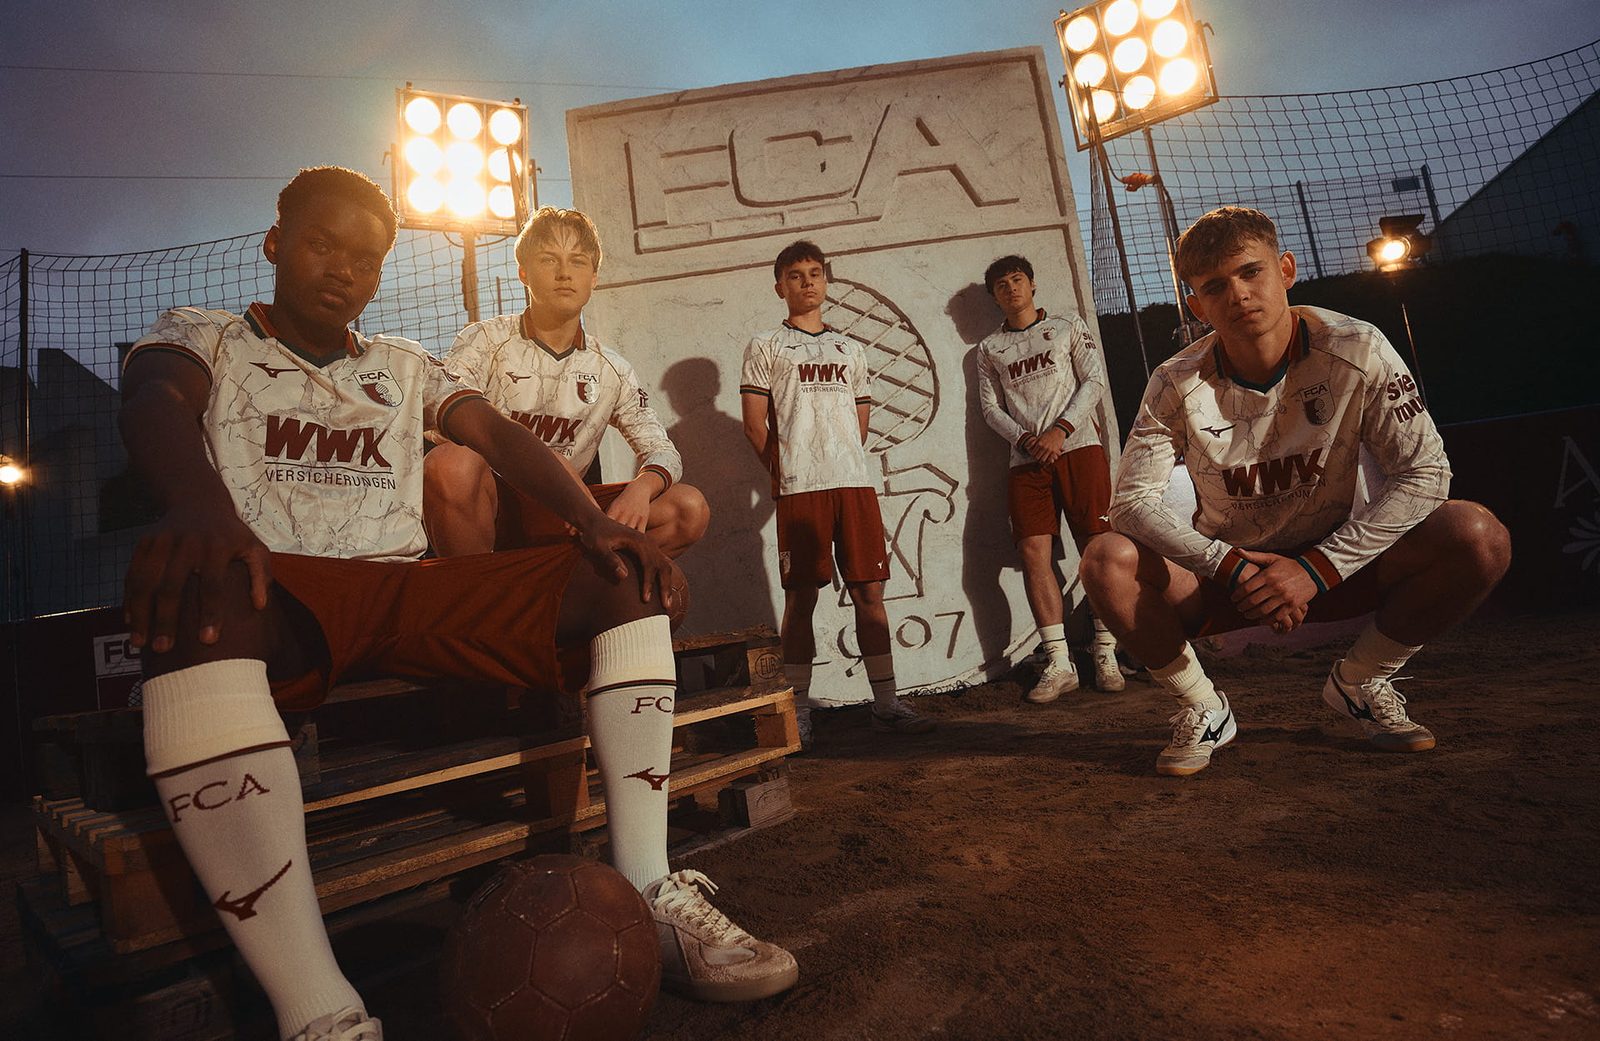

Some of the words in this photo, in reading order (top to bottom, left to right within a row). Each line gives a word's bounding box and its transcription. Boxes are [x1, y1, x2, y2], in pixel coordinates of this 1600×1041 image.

[623, 102, 1020, 230] FCA
[359, 371, 390, 382] FCA
[798, 363, 848, 384] WWK
[1008, 350, 1055, 380] WWK
[1303, 385, 1329, 399] FCA
[264, 414, 393, 468] WWK
[265, 469, 397, 490] VERSICHERUNGEN
[1222, 447, 1325, 497] WWK
[630, 696, 674, 715] FC
[167, 773, 270, 824] FCA
